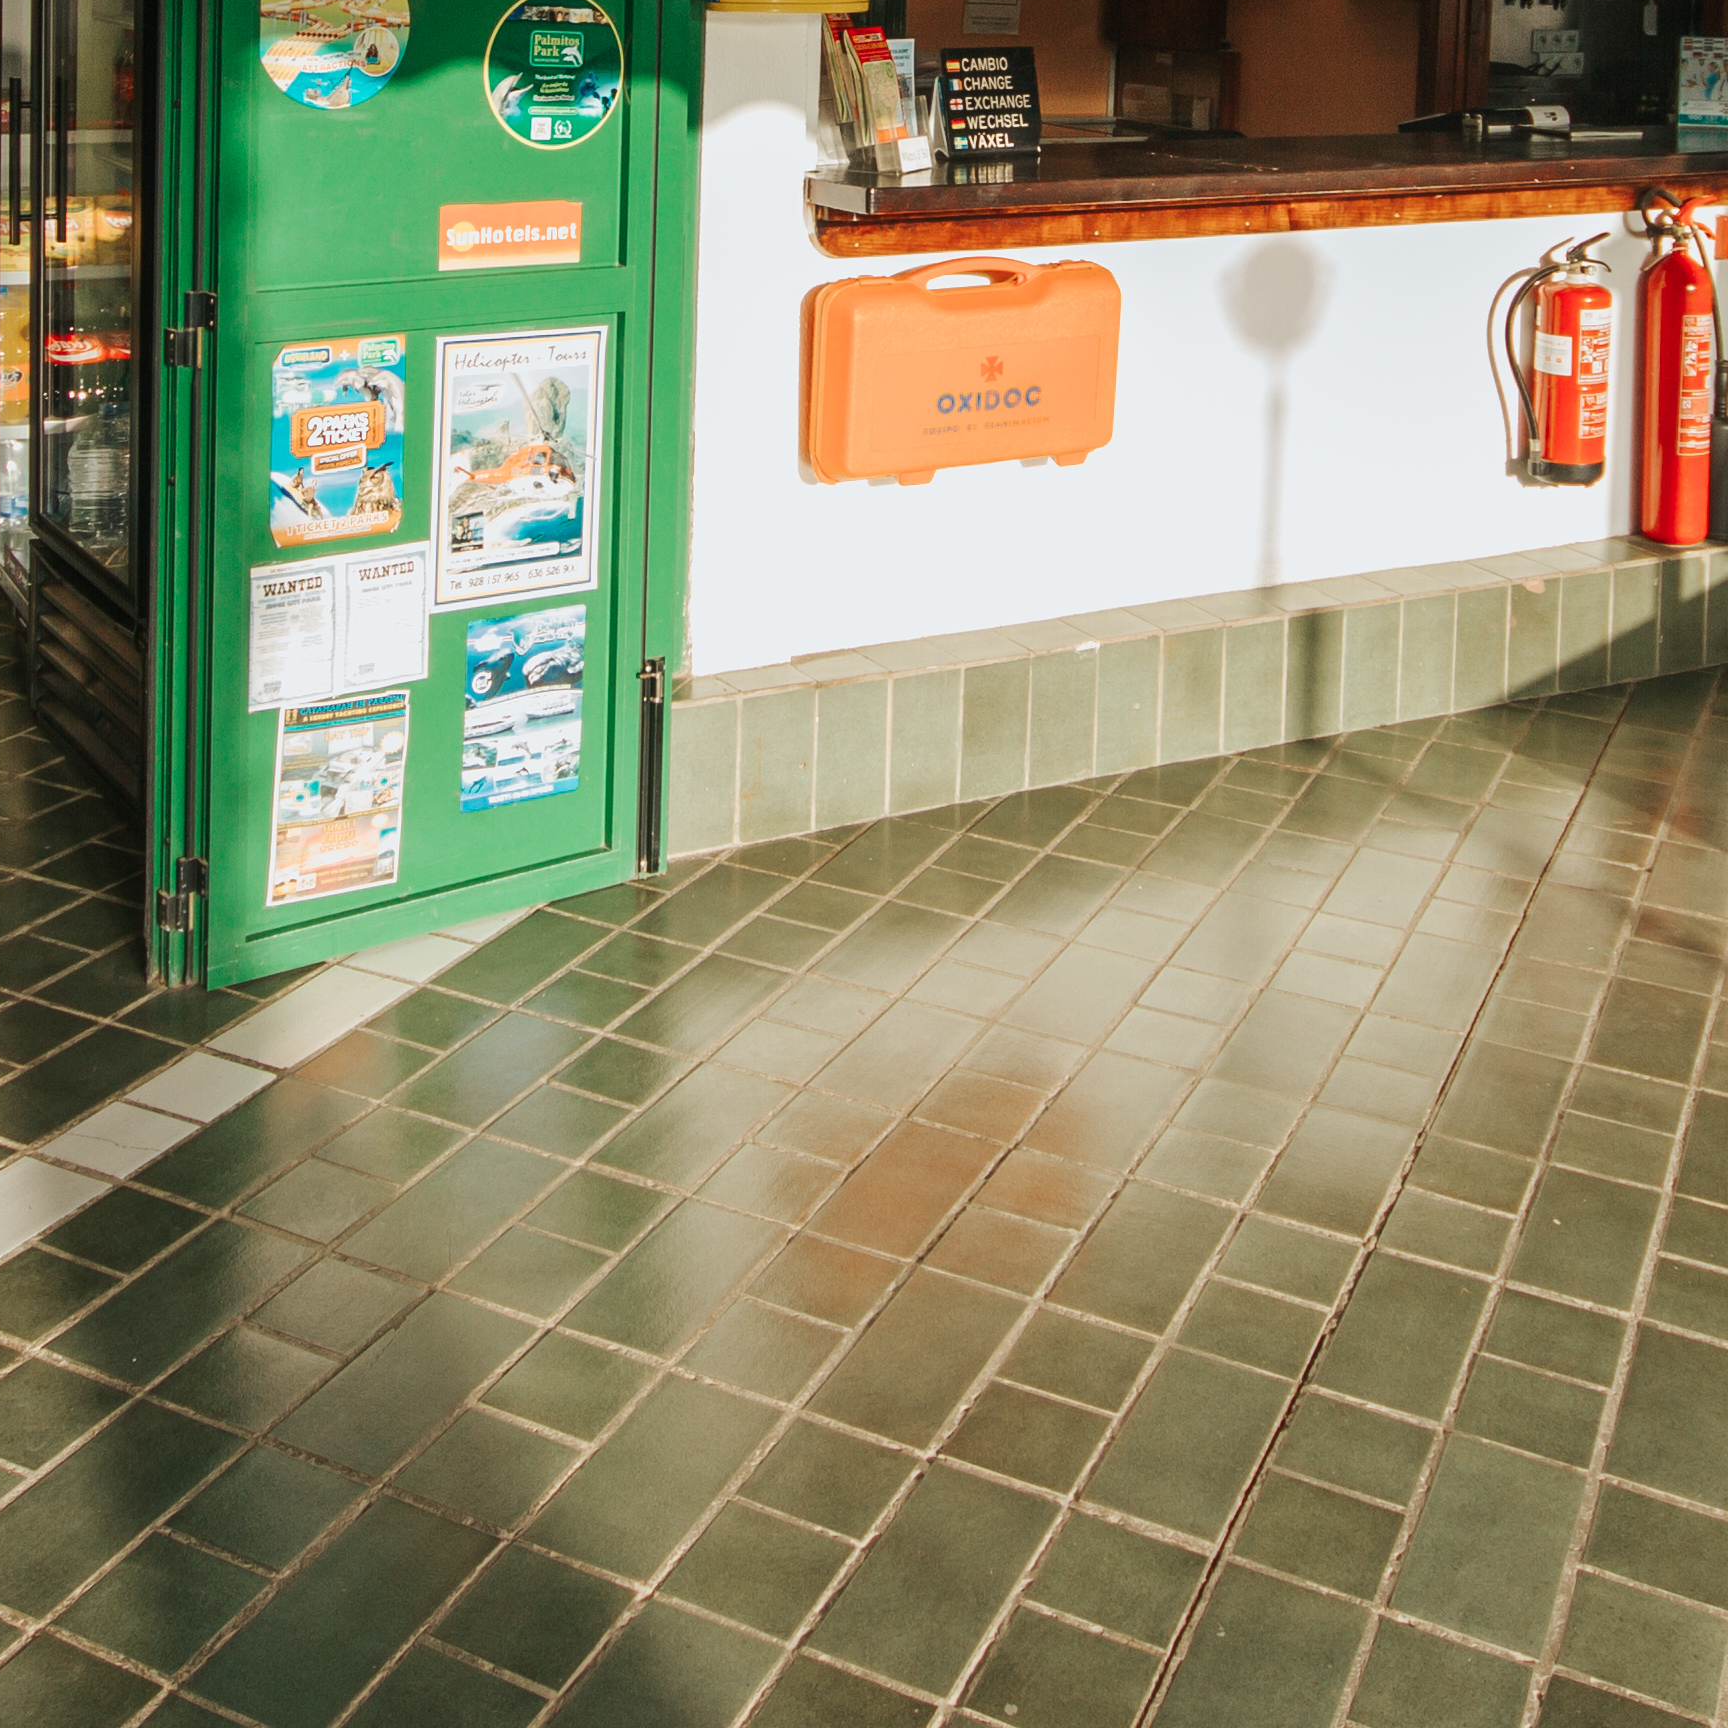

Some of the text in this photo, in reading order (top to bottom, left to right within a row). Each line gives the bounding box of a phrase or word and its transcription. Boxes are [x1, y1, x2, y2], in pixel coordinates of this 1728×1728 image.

[534, 34, 580, 46] Palmitos
[534, 45, 559, 57] Park
[302, 59, 367, 72] ATTRACTIONS
[961, 57, 1008, 73] CAMBIO
[964, 76, 1014, 92] CHANGE
[965, 94, 1032, 111] EXCHANGE
[966, 113, 1030, 130] WECHSEL
[968, 133, 1015, 150] VÄXEL
[446, 222, 577, 247] SunHotels.net
[454, 351, 530, 372] Helicopter
[547, 345, 587, 361] Tours
[937, 385, 1042, 415] OXIDOC
[306, 416, 323, 447] 2
[322, 412, 369, 432] PARKS
[322, 426, 369, 444] TICKET
[286, 524, 294, 537] 1
[295, 518, 337, 534] TICKET
[348, 511, 390, 527] PARKS
[263, 576, 323, 597] WANTED
[358, 560, 415, 582] WANTED
[468, 575, 484, 588] 928
[487, 574, 501, 585] 157
[503, 571, 520, 583] 965
[527, 567, 544, 579] 636
[545, 565, 561, 577] 526
[299, 701, 353, 716] CATAMARAN
[302, 715, 309, 723] A
[322, 819, 357, 833] SUNSET
[321, 831, 356, 844] CRUISE
